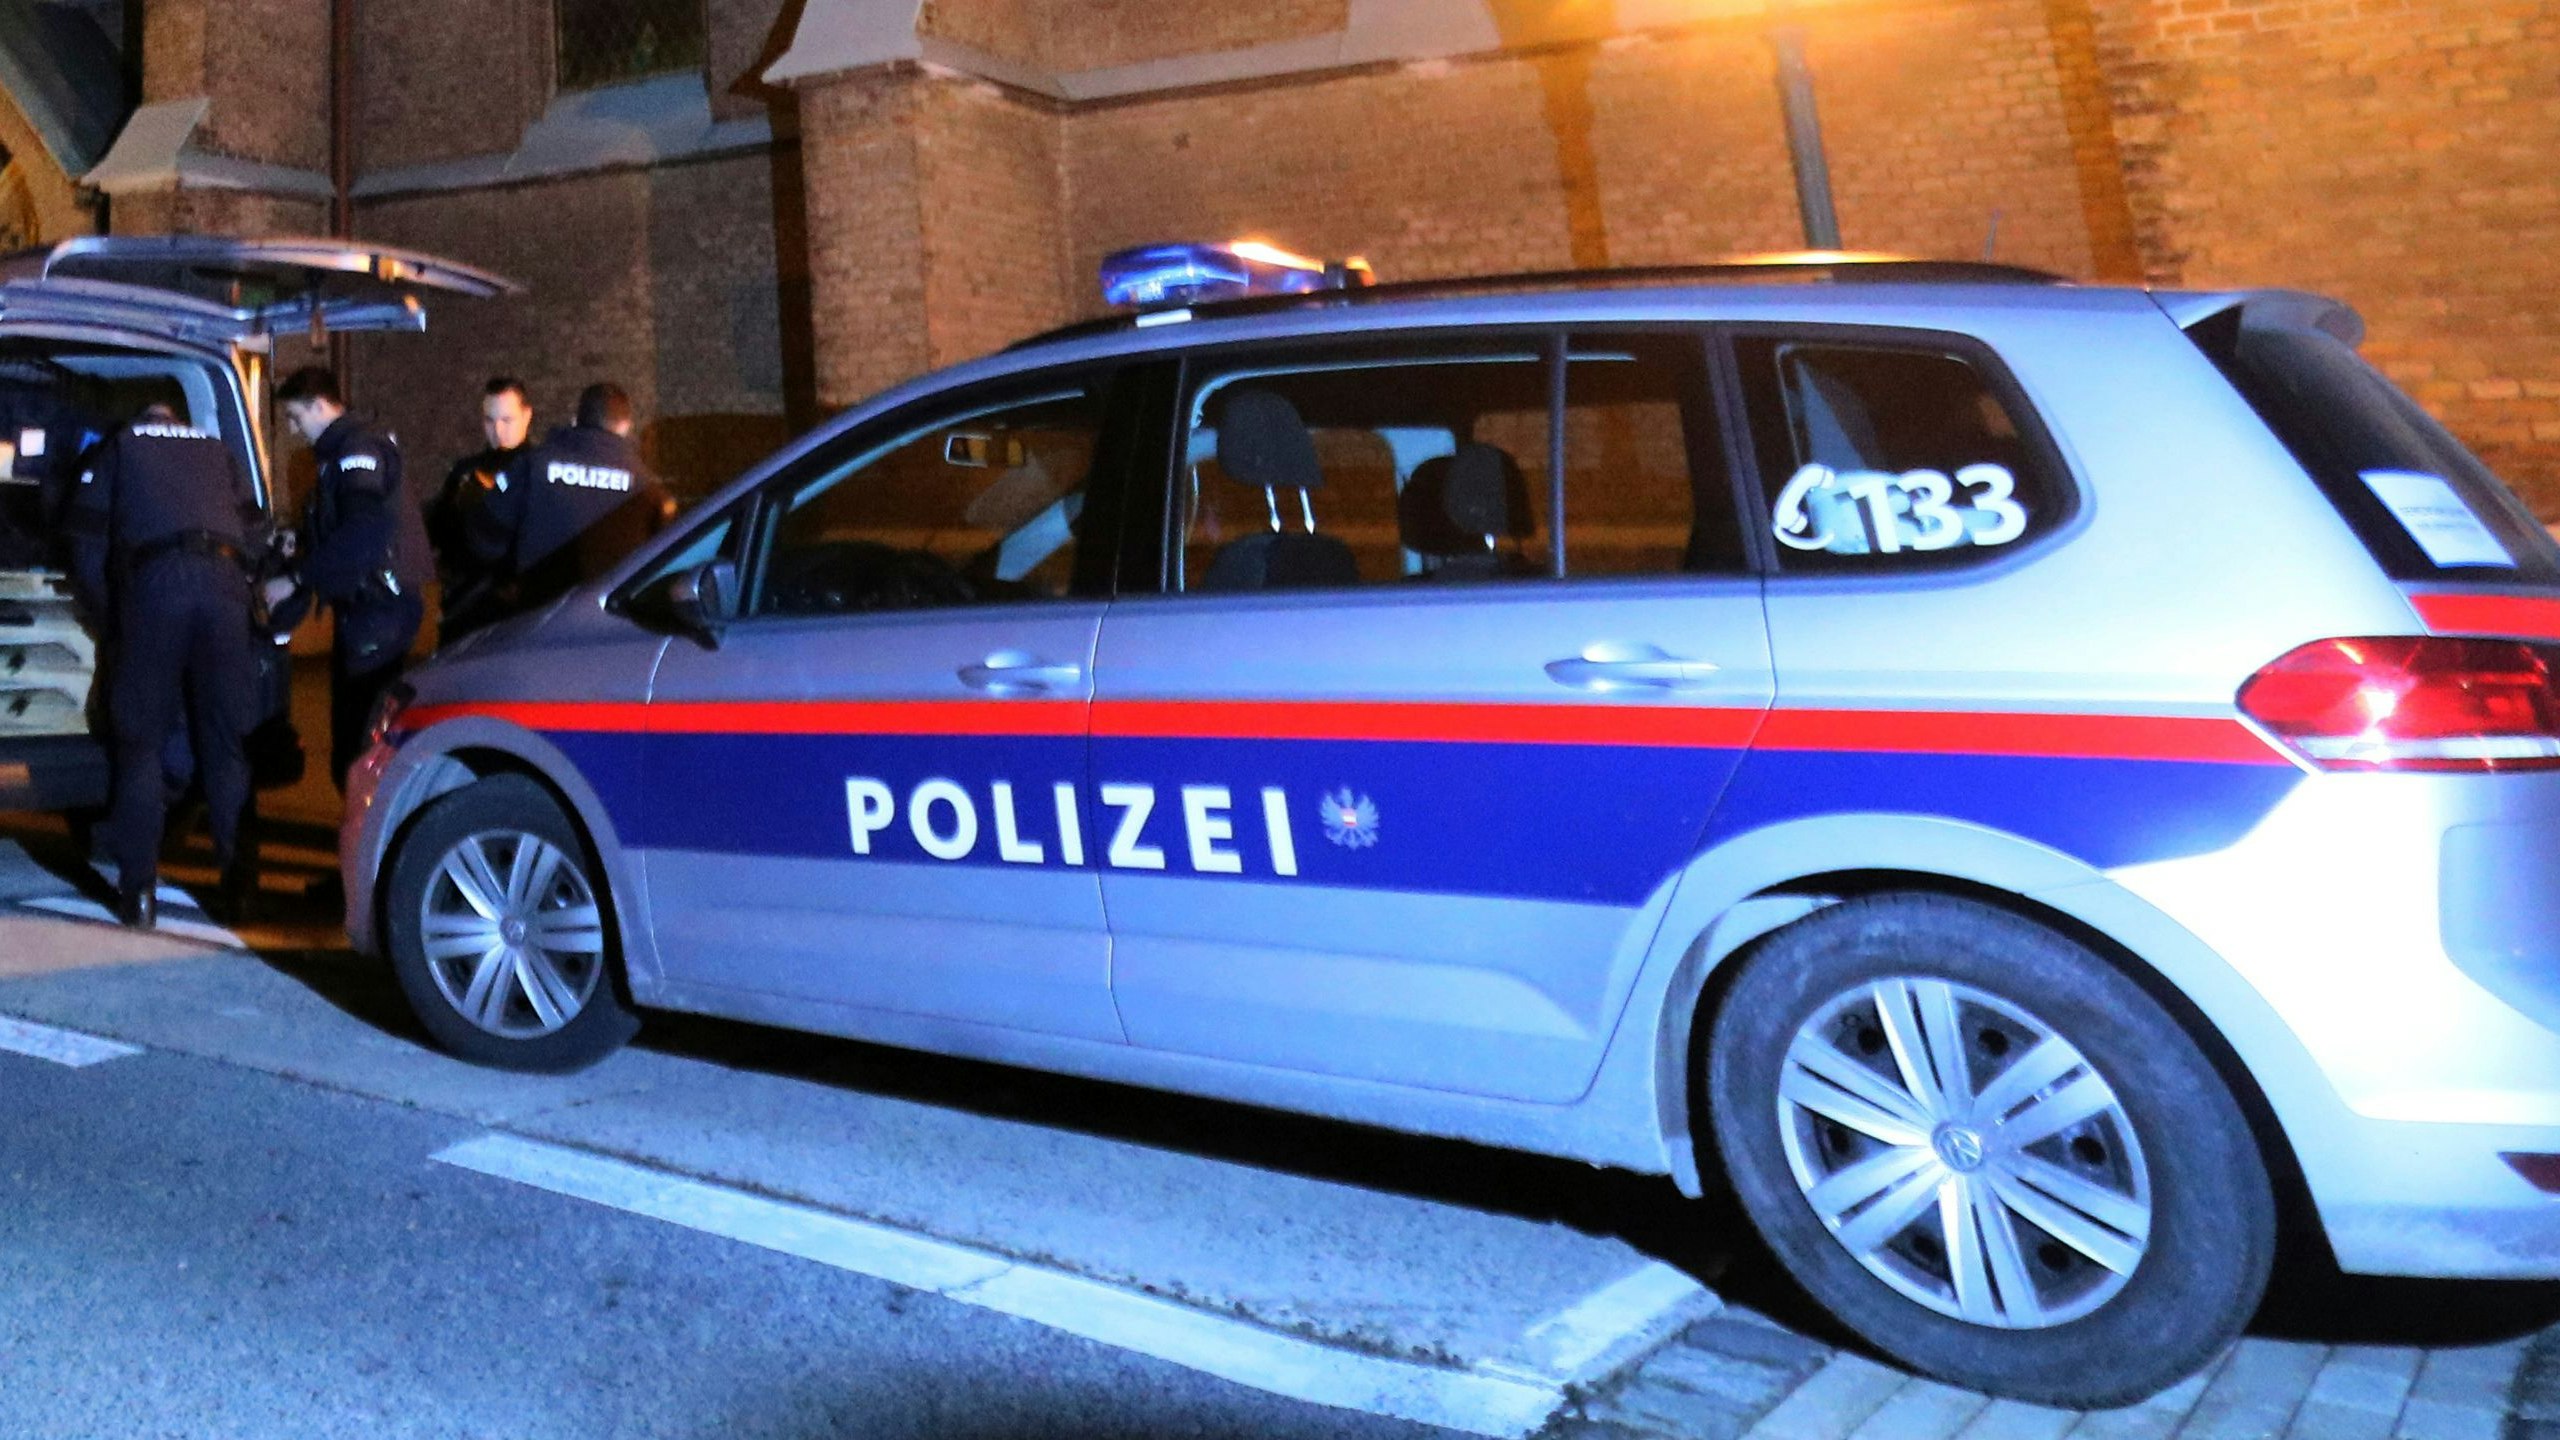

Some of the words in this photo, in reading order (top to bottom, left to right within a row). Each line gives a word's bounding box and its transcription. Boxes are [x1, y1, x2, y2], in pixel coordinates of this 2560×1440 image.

[340, 455, 376, 472] POLIZEI
[547, 461, 631, 492] POLIZEI
[1850, 463, 2027, 554] 133
[845, 777, 1298, 876] POLIZEI
